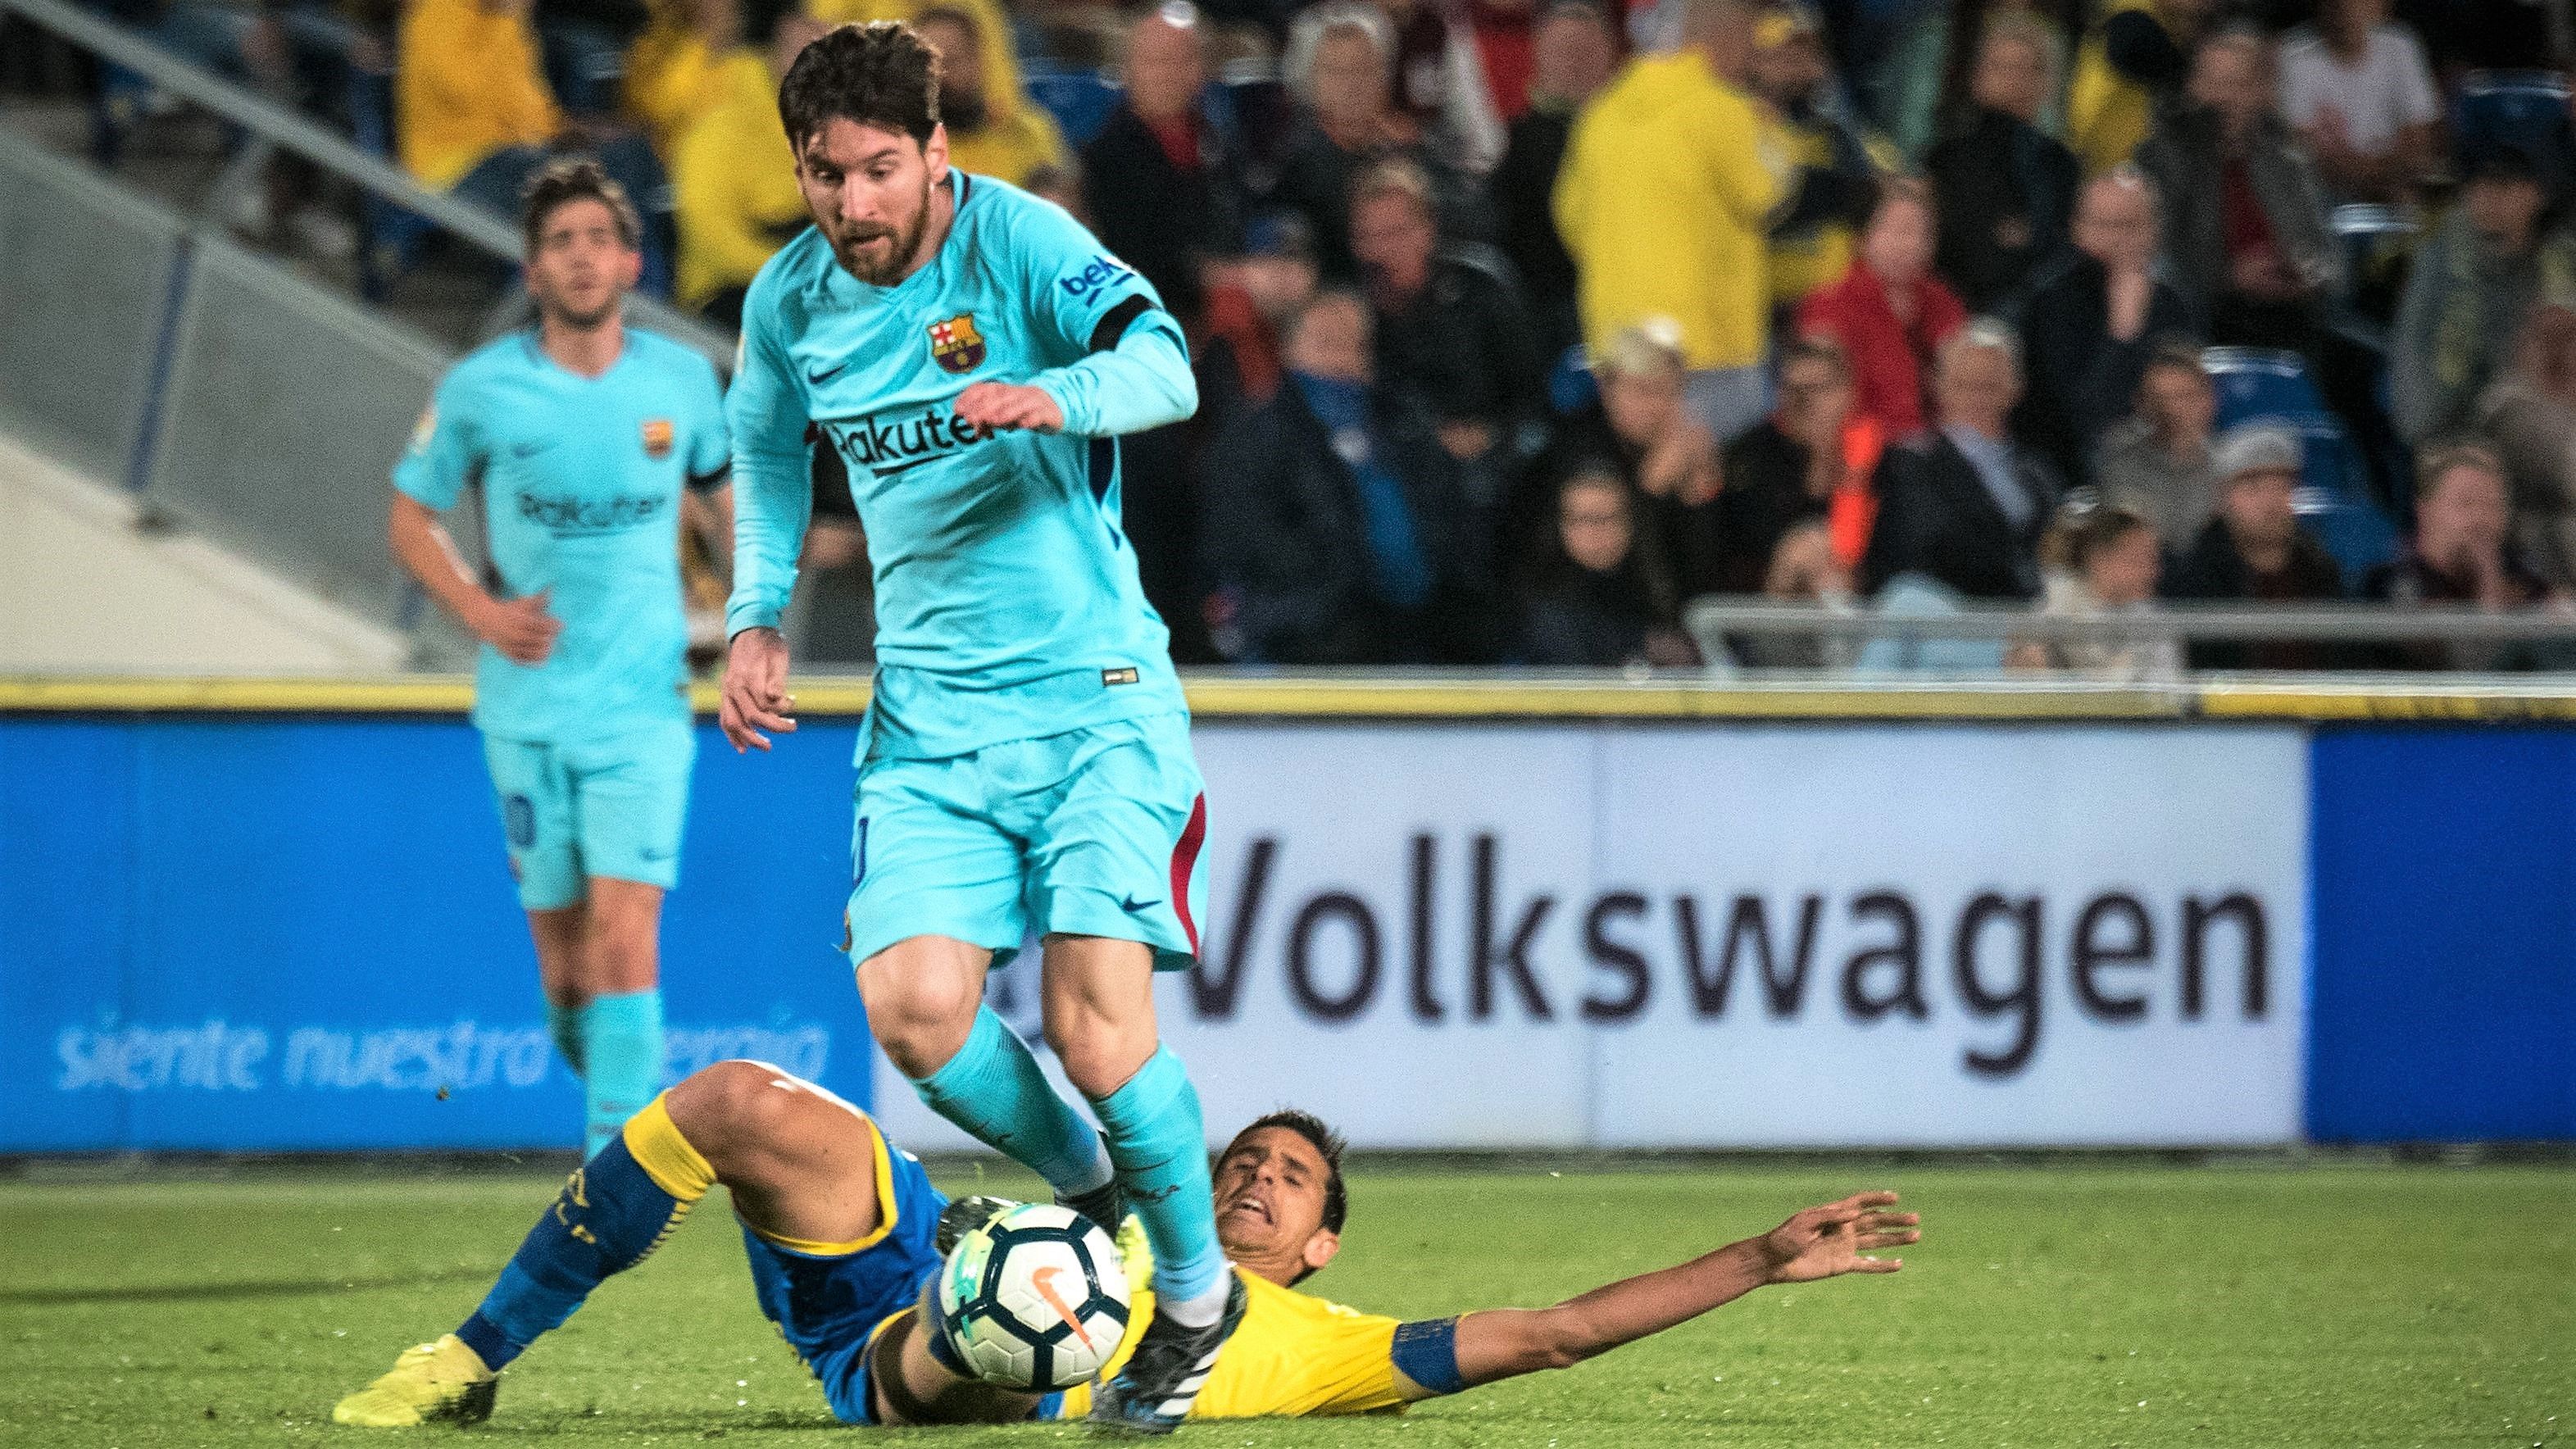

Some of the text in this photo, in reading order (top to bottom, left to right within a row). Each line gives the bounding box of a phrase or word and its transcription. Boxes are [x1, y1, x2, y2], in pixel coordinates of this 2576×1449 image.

[1059, 255, 1124, 295] bek
[829, 410, 995, 466] Rakute
[1188, 833, 2272, 1081] Volkswagen
[58, 1005, 269, 1090] siente
